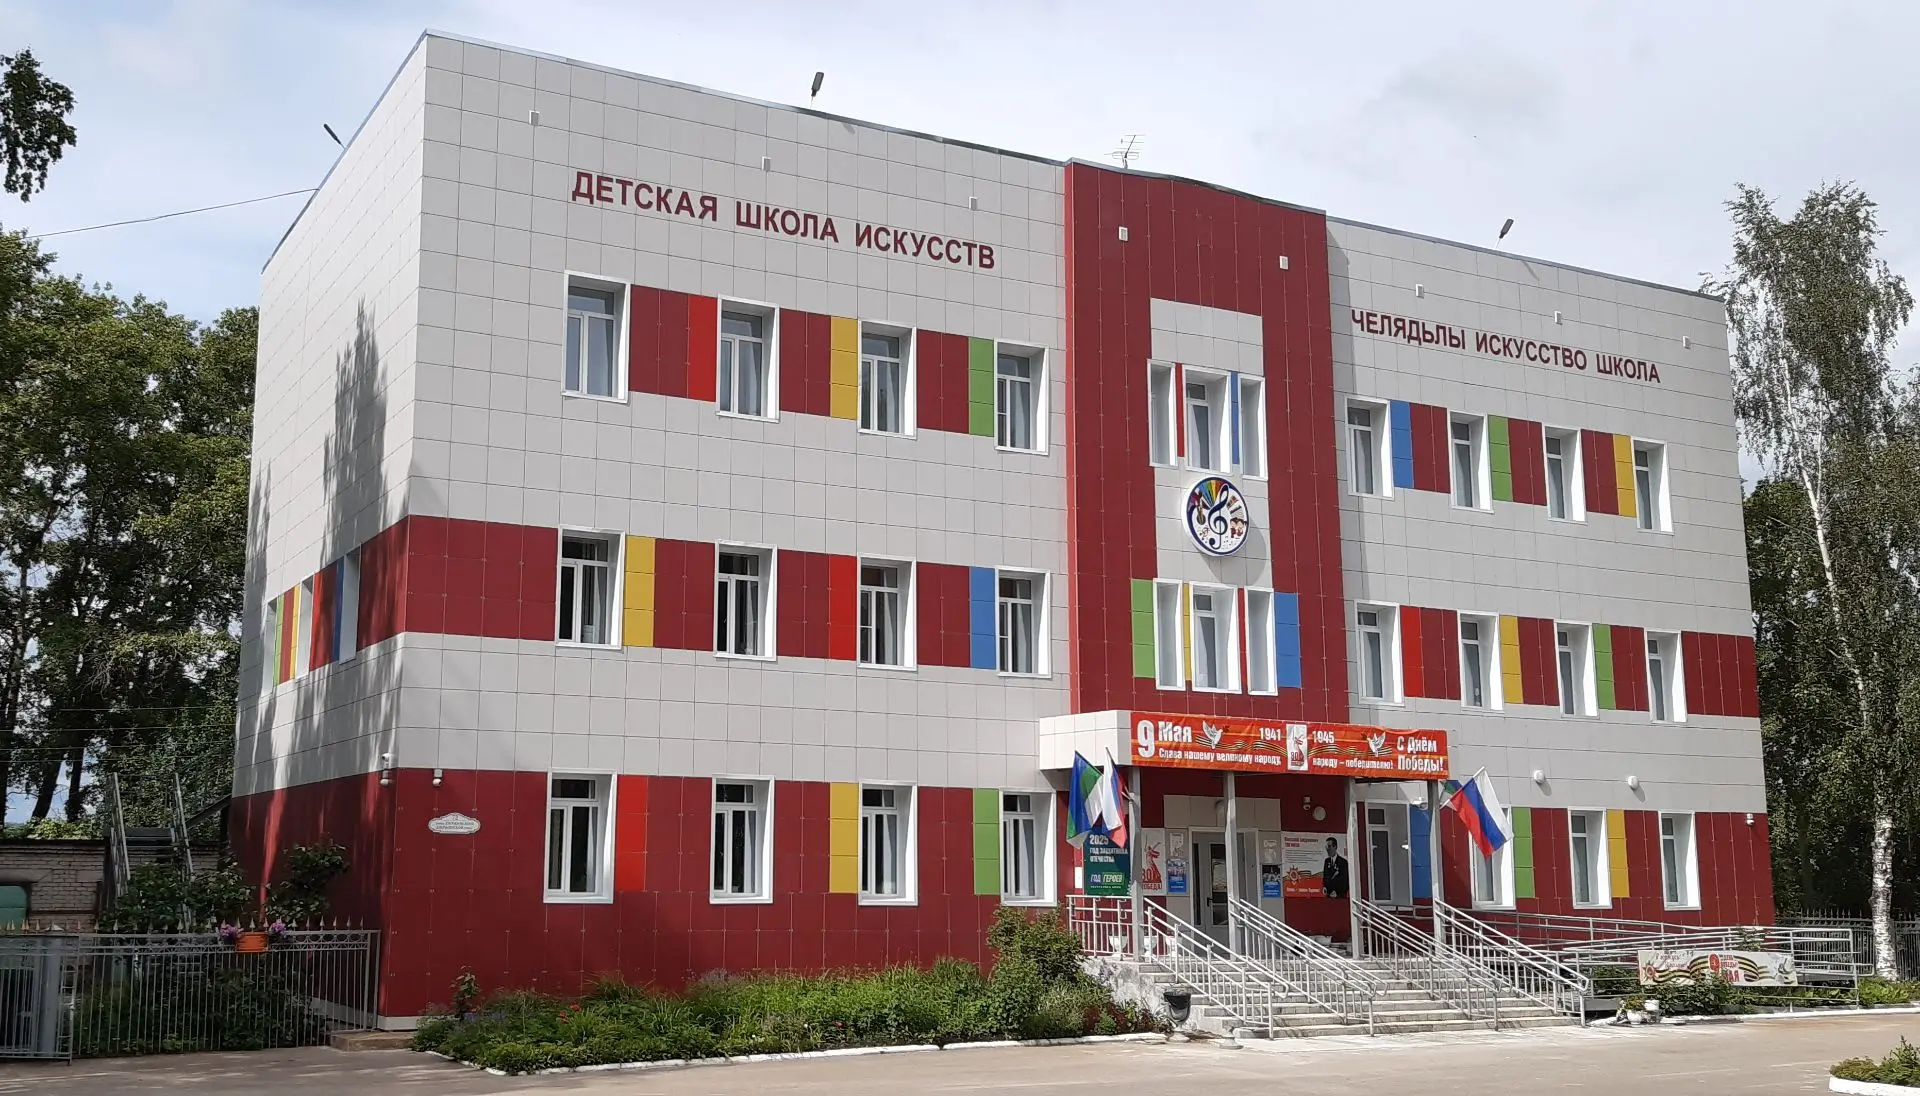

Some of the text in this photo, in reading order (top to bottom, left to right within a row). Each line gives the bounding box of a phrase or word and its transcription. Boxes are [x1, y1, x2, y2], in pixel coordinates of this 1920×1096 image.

[572, 171, 995, 269] ДЕТСКАЯ ШКОЛА ИСКУССТВ
[1351, 308, 1661, 384] ЧЕЛЯДЬЛЫ ИСКУССТВО ШКОЛА
[1137, 719, 1193, 759] 9 Мая
[1259, 727, 1335, 744] 1941 1945
[1397, 735, 1437, 754] С Днём
[1158, 747, 1183, 760] Слава
[1184, 750, 1215, 763] нашему
[1216, 751, 1253, 765] великому
[1312, 757, 1338, 770] народу
[1345, 758, 1394, 770] победителю!
[1397, 754, 1444, 773] Победы!
[1089, 834, 1109, 845] 2025
[1090, 873, 1123, 883] ГОД ГЕРОЕВ
